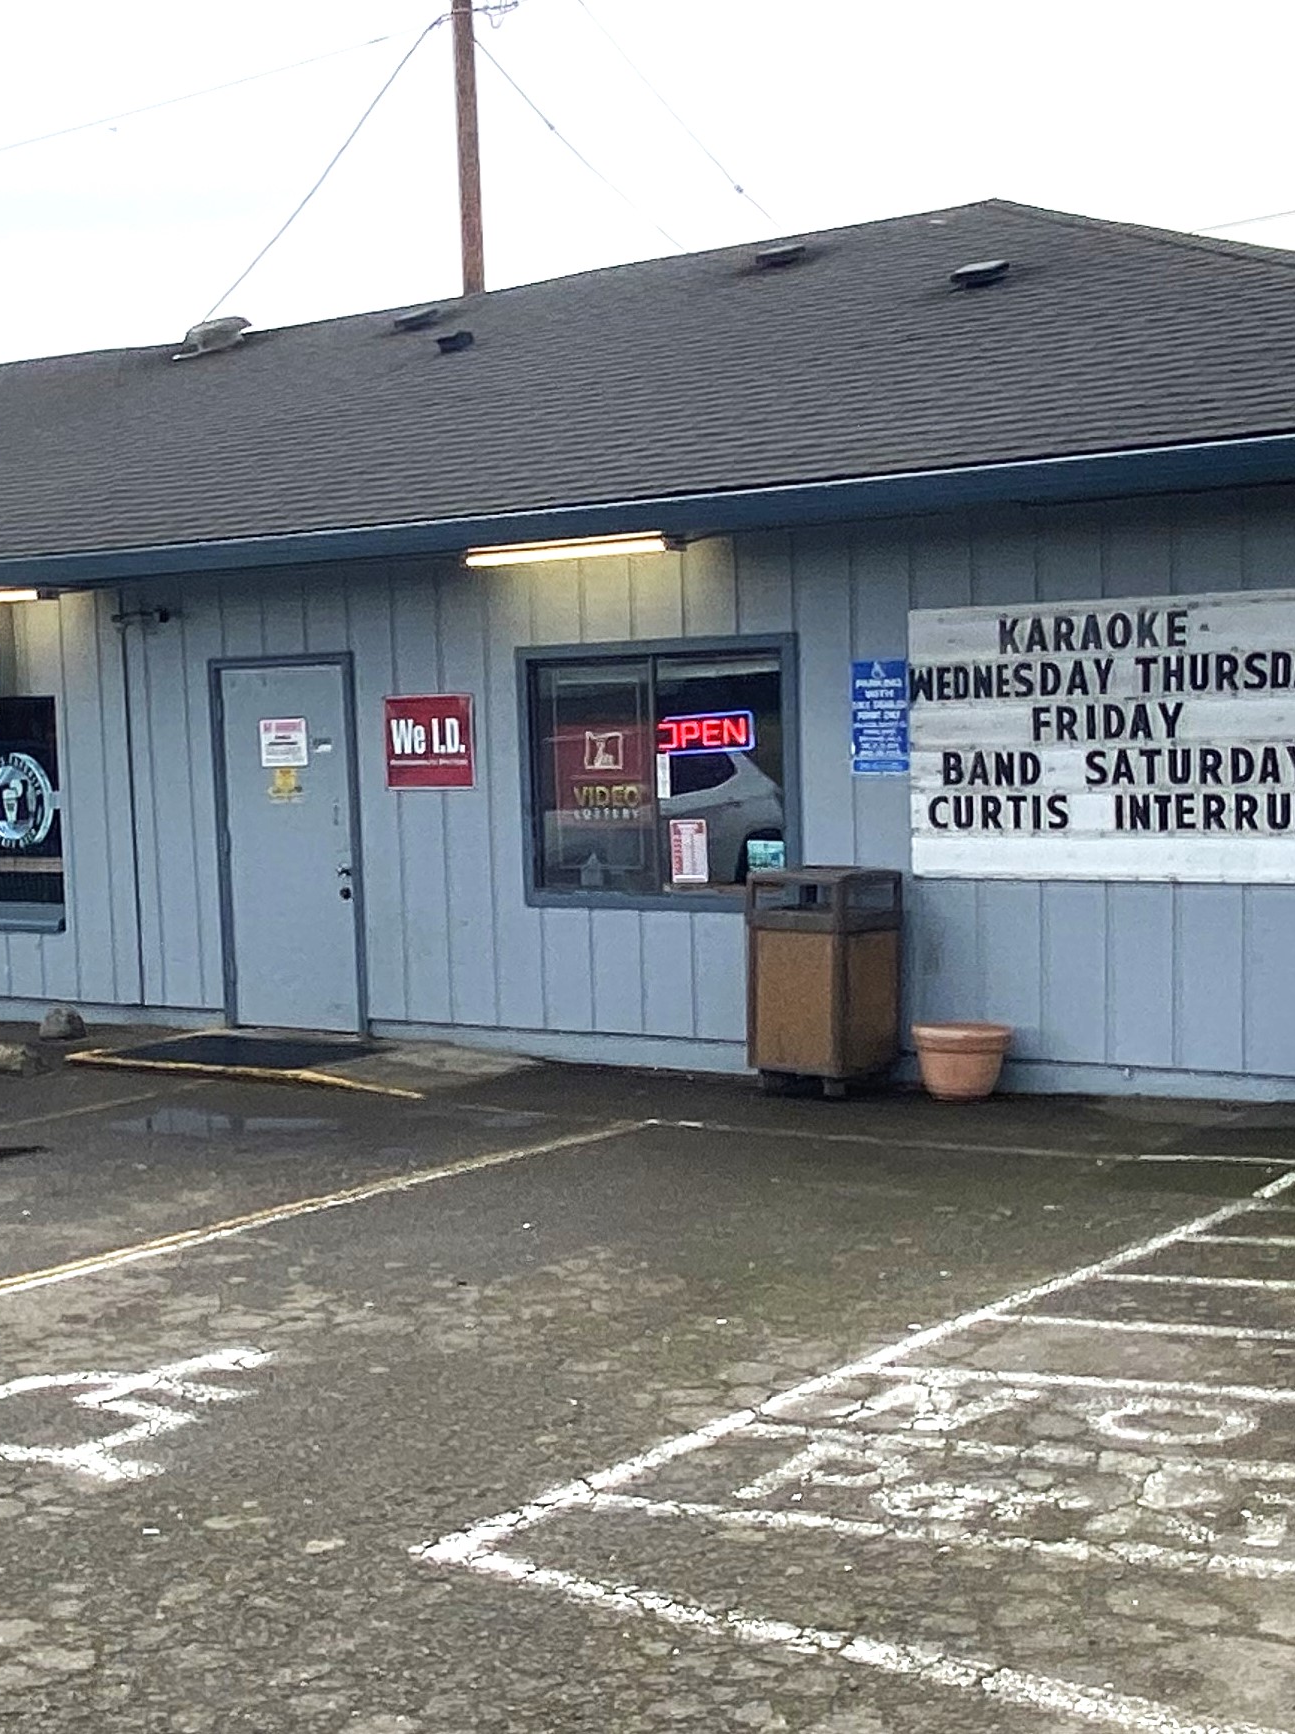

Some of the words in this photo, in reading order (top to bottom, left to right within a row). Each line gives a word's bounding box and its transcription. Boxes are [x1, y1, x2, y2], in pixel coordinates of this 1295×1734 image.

[999, 610, 1189, 654] KARAOKE
[909, 658, 1115, 701] WEDNESDAY
[390, 718, 426, 754] We
[431, 717, 466, 754] I.D.
[658, 716, 747, 749] OPEN
[1033, 702, 1183, 741] FRIDAY
[943, 751, 1042, 786] BAND
[574, 784, 640, 807] VIDEO
[928, 795, 1069, 830] CURTIS
